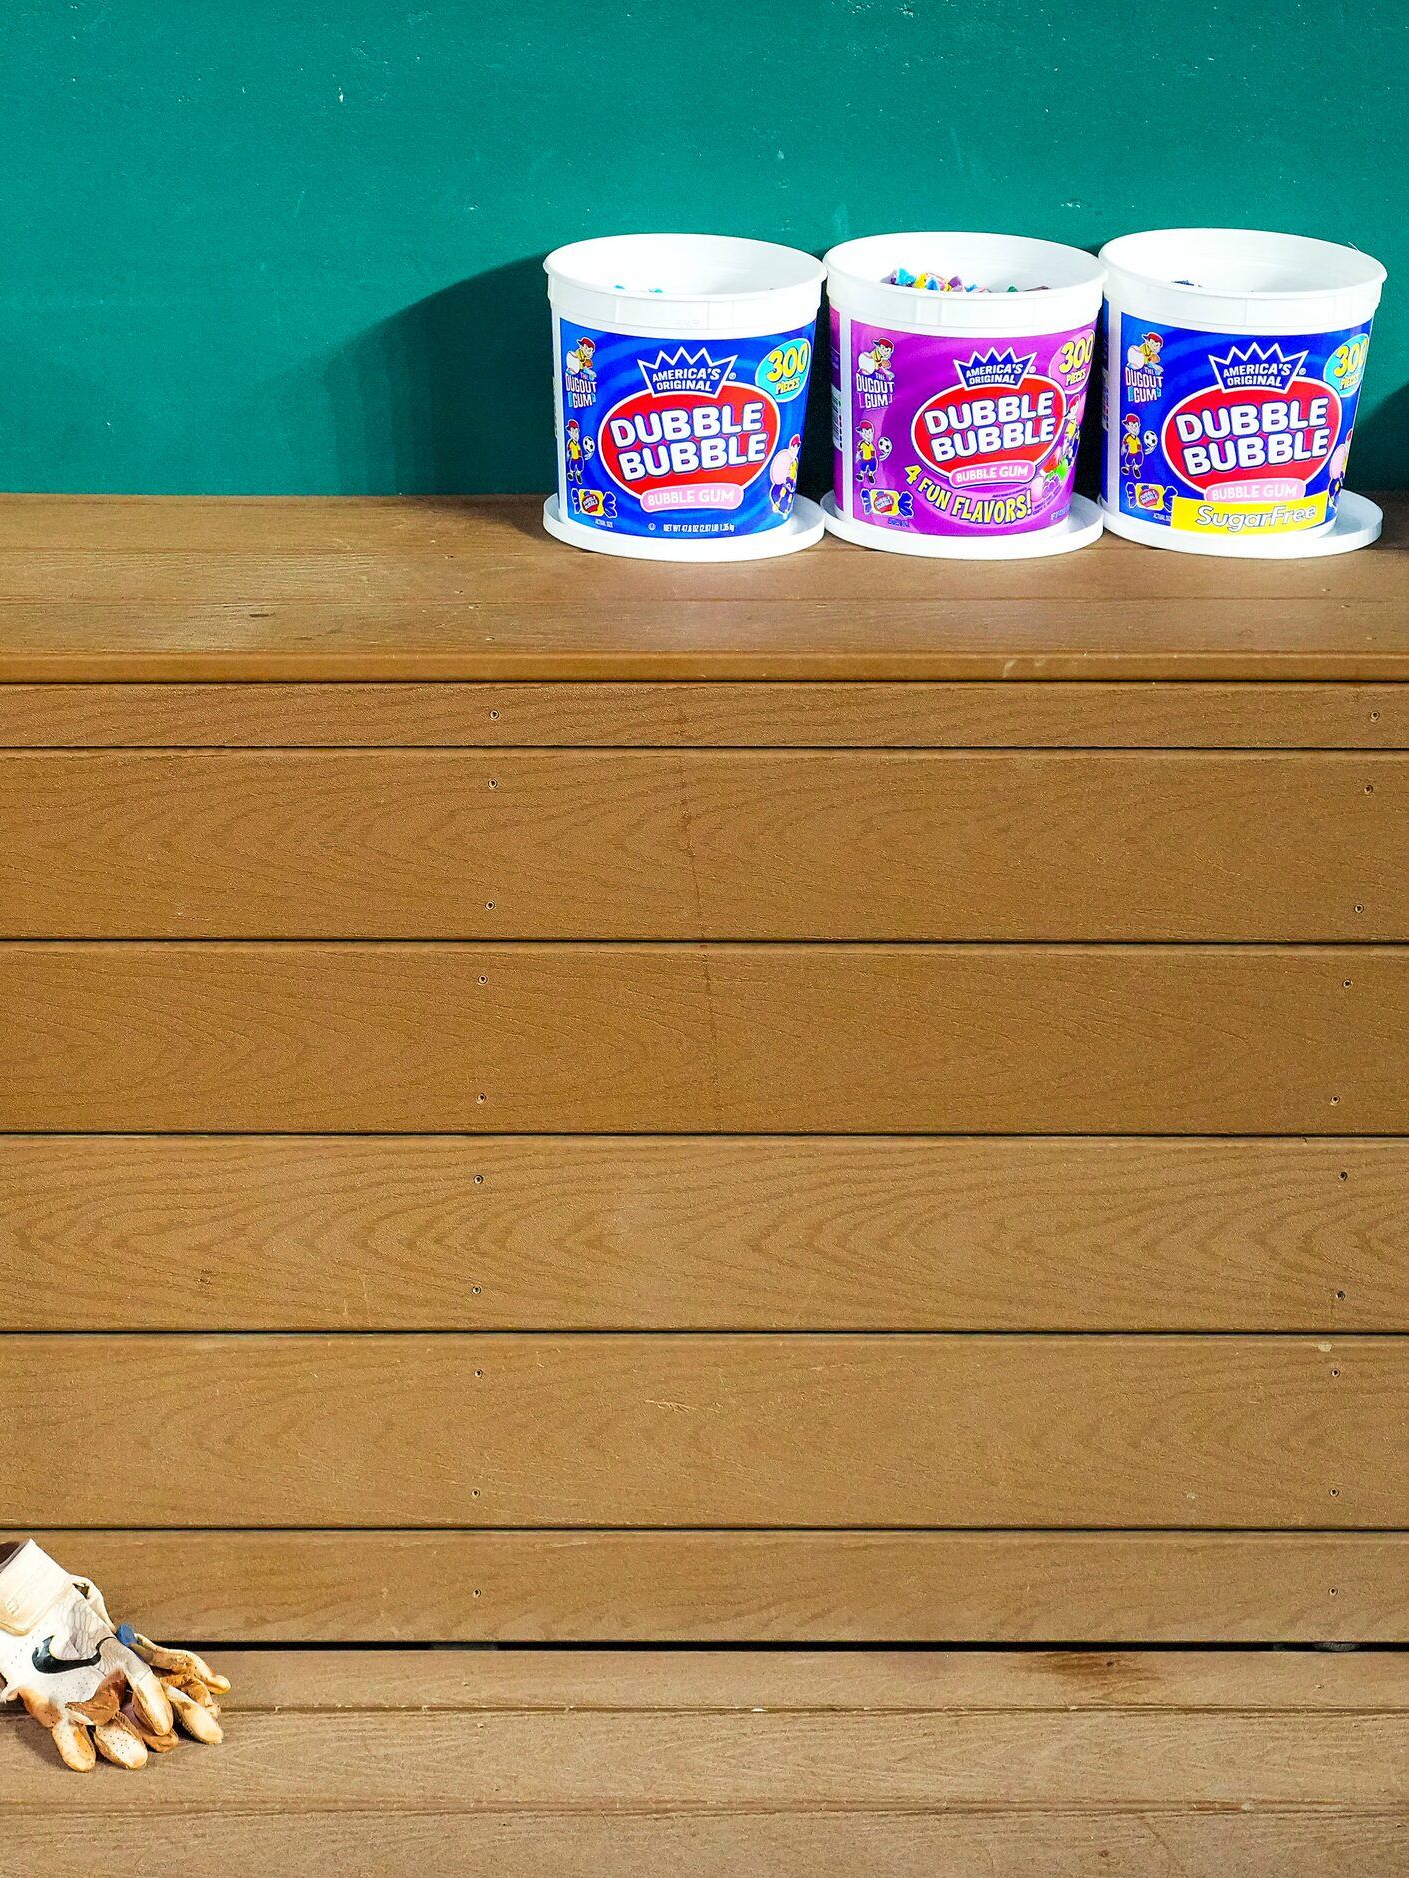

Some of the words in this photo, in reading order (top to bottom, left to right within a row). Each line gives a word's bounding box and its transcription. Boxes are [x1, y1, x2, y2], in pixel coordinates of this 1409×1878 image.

[766, 342, 809, 383] 300
[1059, 332, 1094, 374] 300
[652, 367, 721, 382] AMERICA'S
[966, 363, 1024, 378] AMERICA'S
[969, 375, 1016, 385] ORIGINAL
[1125, 366, 1164, 388] DUGOUT
[1223, 363, 1292, 378] AMERICA'S
[565, 371, 597, 393] DUGOUT
[656, 380, 712, 392] ORIGINAL
[776, 377, 801, 395] PIECES
[856, 372, 895, 393] DUGOUT
[1227, 375, 1282, 387] ORIGINAL
[573, 393, 592, 408] GUM
[865, 393, 889, 409] GUM
[1133, 387, 1157, 403] GUM
[924, 391, 1055, 435] DUBBLE
[1176, 397, 1329, 443] DUBBLE
[610, 402, 764, 448] DUBBLE
[930, 417, 1056, 462] BUBBLE
[618, 432, 768, 481] BUBBLE
[1183, 428, 1330, 476] BUBBLE
[956, 467, 997, 482] BUBBLE
[999, 465, 1029, 478] GUM
[647, 490, 697, 507] BUBBLE
[698, 488, 735, 503] GUM
[904, 465, 922, 485] 4
[917, 476, 952, 511] FUN
[951, 489, 1031, 524] FLAVORS!
[1212, 485, 1260, 501] BUBBLE
[1262, 483, 1299, 498] GUM
[1195, 505, 1317, 532] SugarFree
